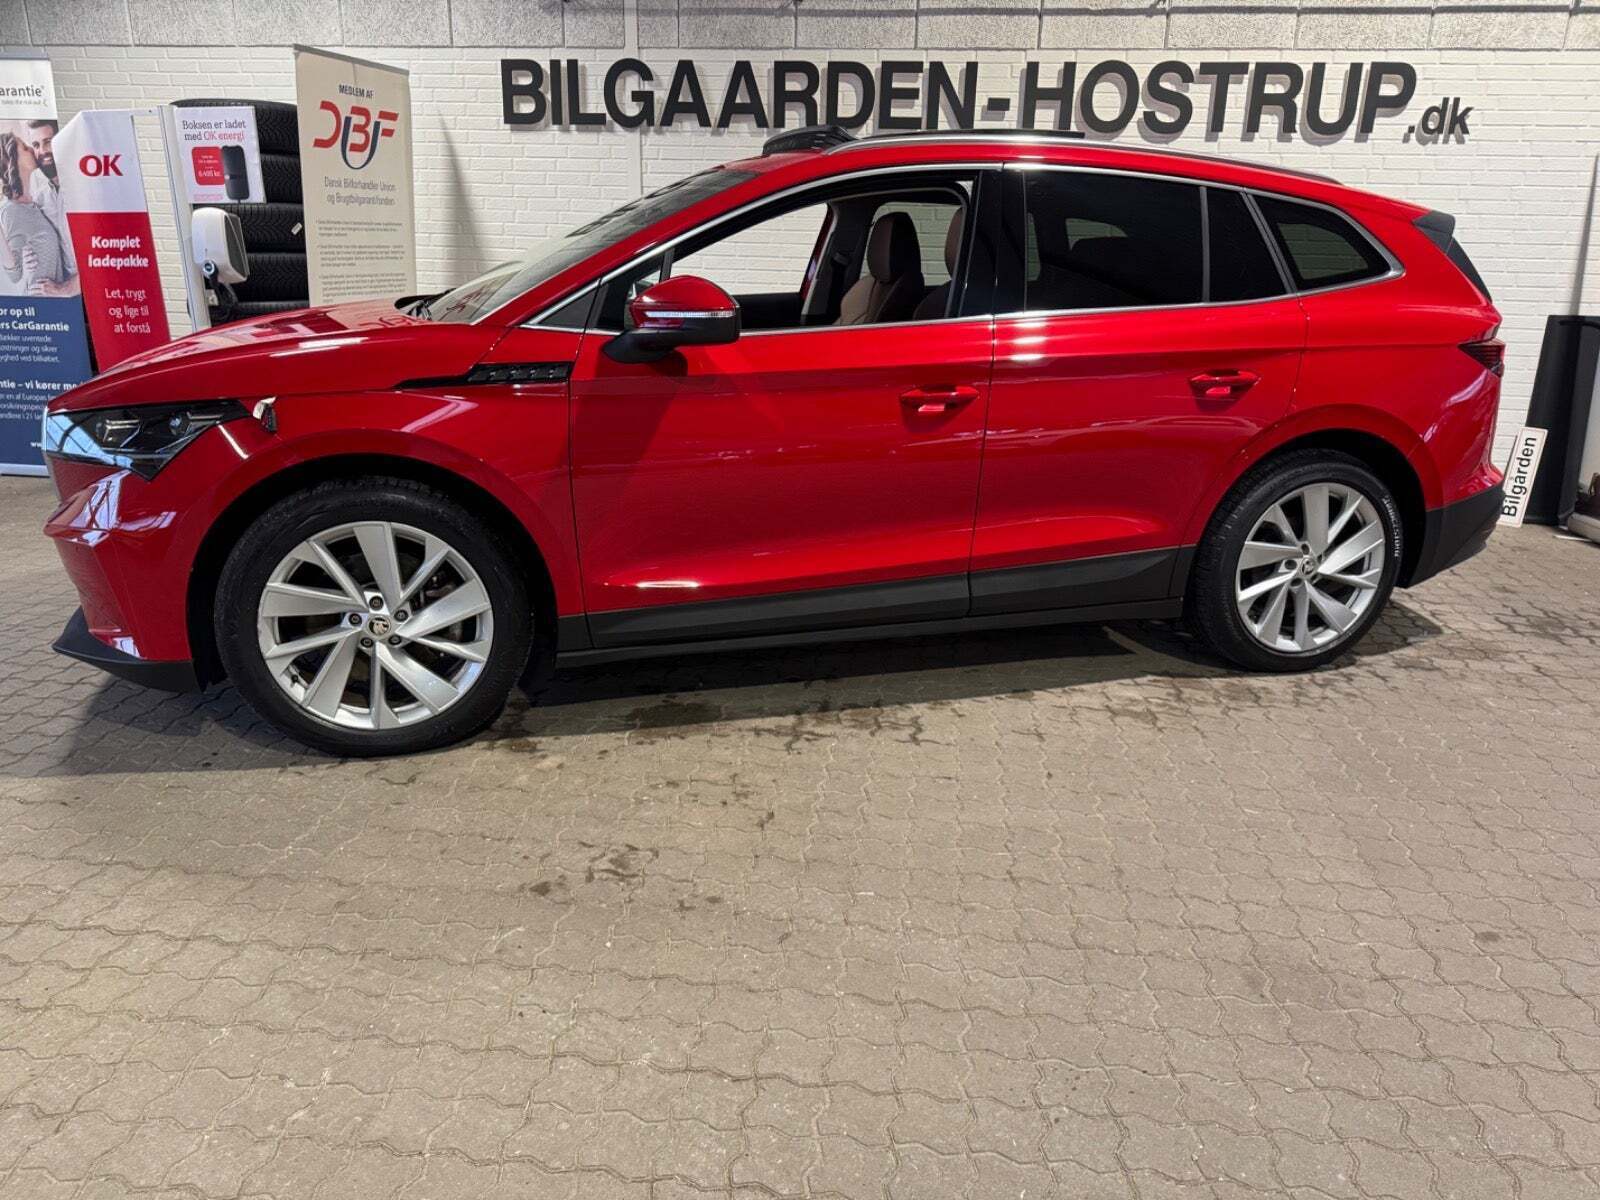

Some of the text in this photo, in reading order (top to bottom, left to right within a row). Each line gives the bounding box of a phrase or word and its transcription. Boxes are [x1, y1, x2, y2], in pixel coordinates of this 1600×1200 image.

[339, 84, 374, 99] MEDLEM AF
[182, 119, 246, 130] Boksen er ladet
[184, 131, 244, 142] med OK energi
[79, 154, 124, 177] OK
[91, 235, 141, 251] Komplet
[88, 254, 149, 270] ladepakke
[104, 287, 146, 302] Let, trygt
[10, 308, 23, 319] op
[24, 306, 35, 317] til
[108, 305, 150, 319] og lige til
[12, 320, 70, 332] CarGarantie
[114, 321, 151, 333] at forstå
[25, 380, 33, 389] vi
[35, 380, 61, 390] kører
